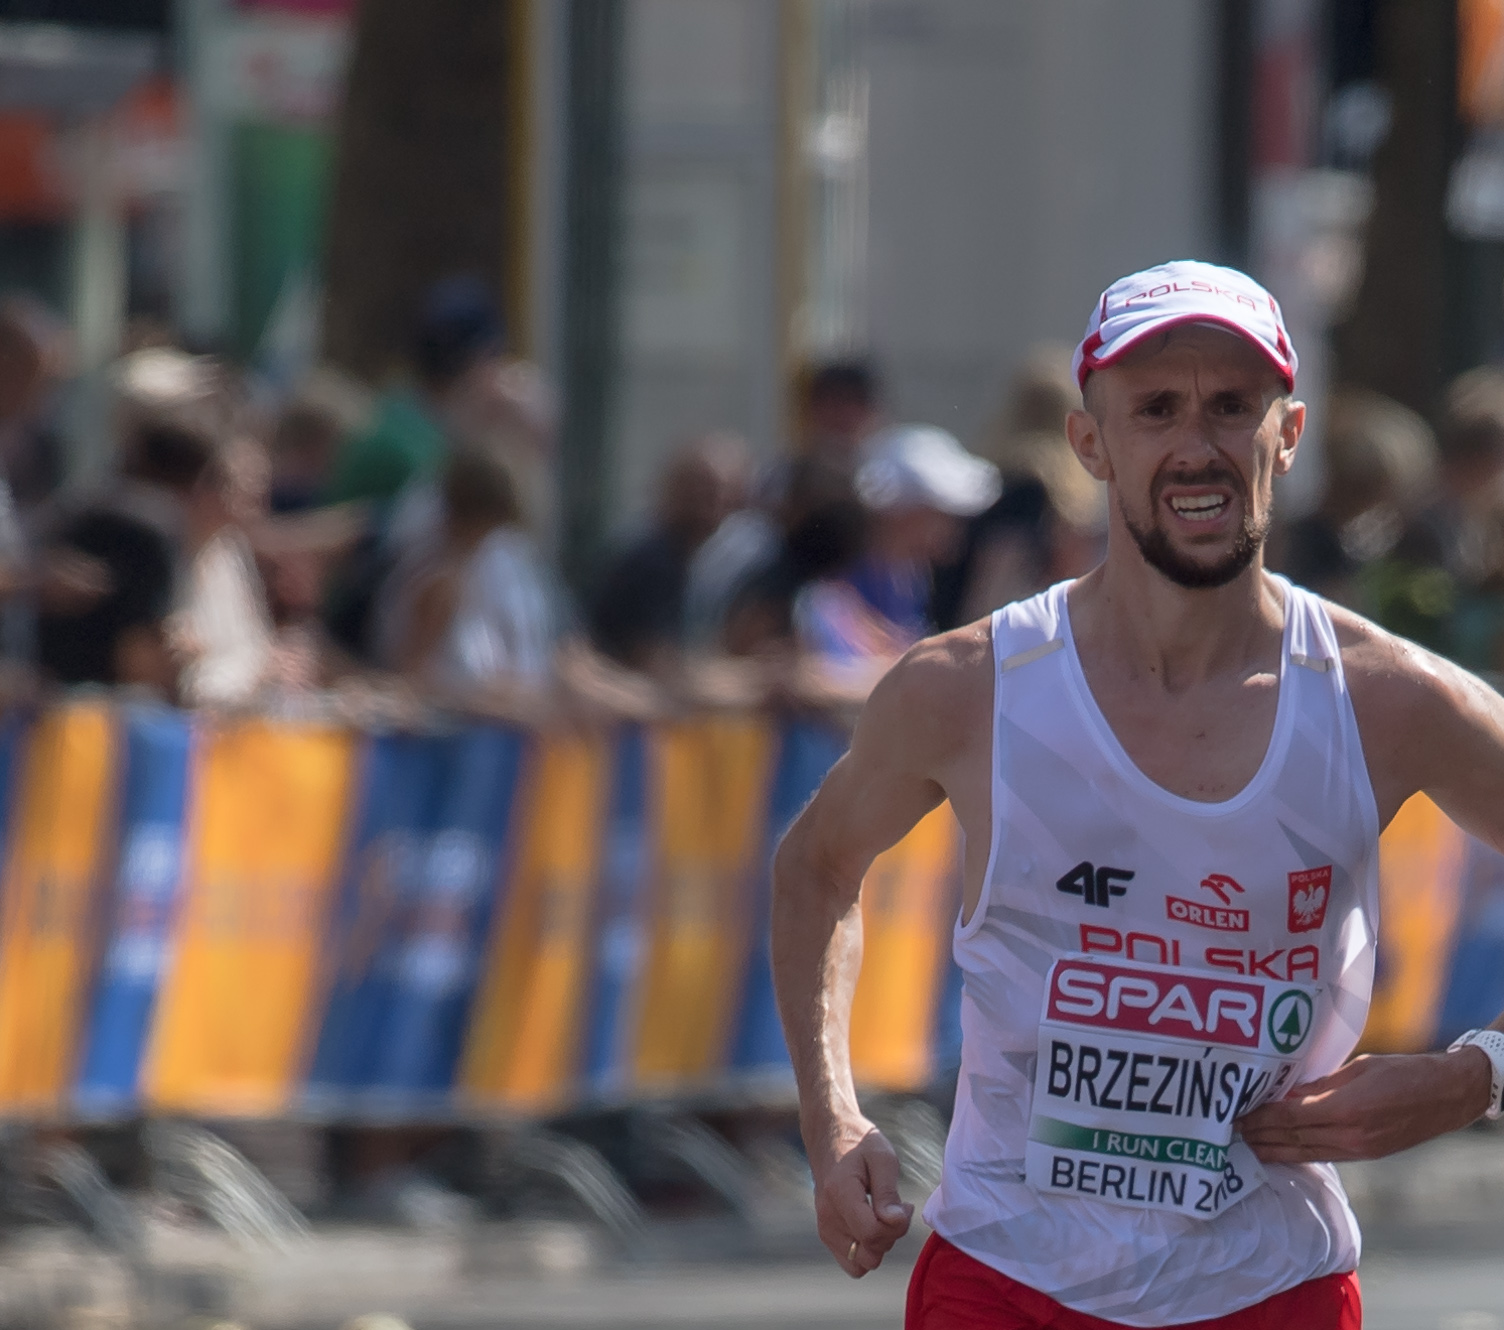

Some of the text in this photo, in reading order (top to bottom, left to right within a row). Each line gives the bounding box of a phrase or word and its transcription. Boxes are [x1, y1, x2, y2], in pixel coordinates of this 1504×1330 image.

[1125, 281, 1256, 311] POLSKA
[1056, 861, 1135, 908] 4F
[1291, 869, 1329, 883] POLSKA
[1171, 901, 1244, 929] ORLEN
[1055, 969, 1259, 1038] SPAR
[1092, 1131, 1099, 1149] I
[1107, 1133, 1160, 1158] RUN
[1051, 1156, 1187, 1206] BERLIN
